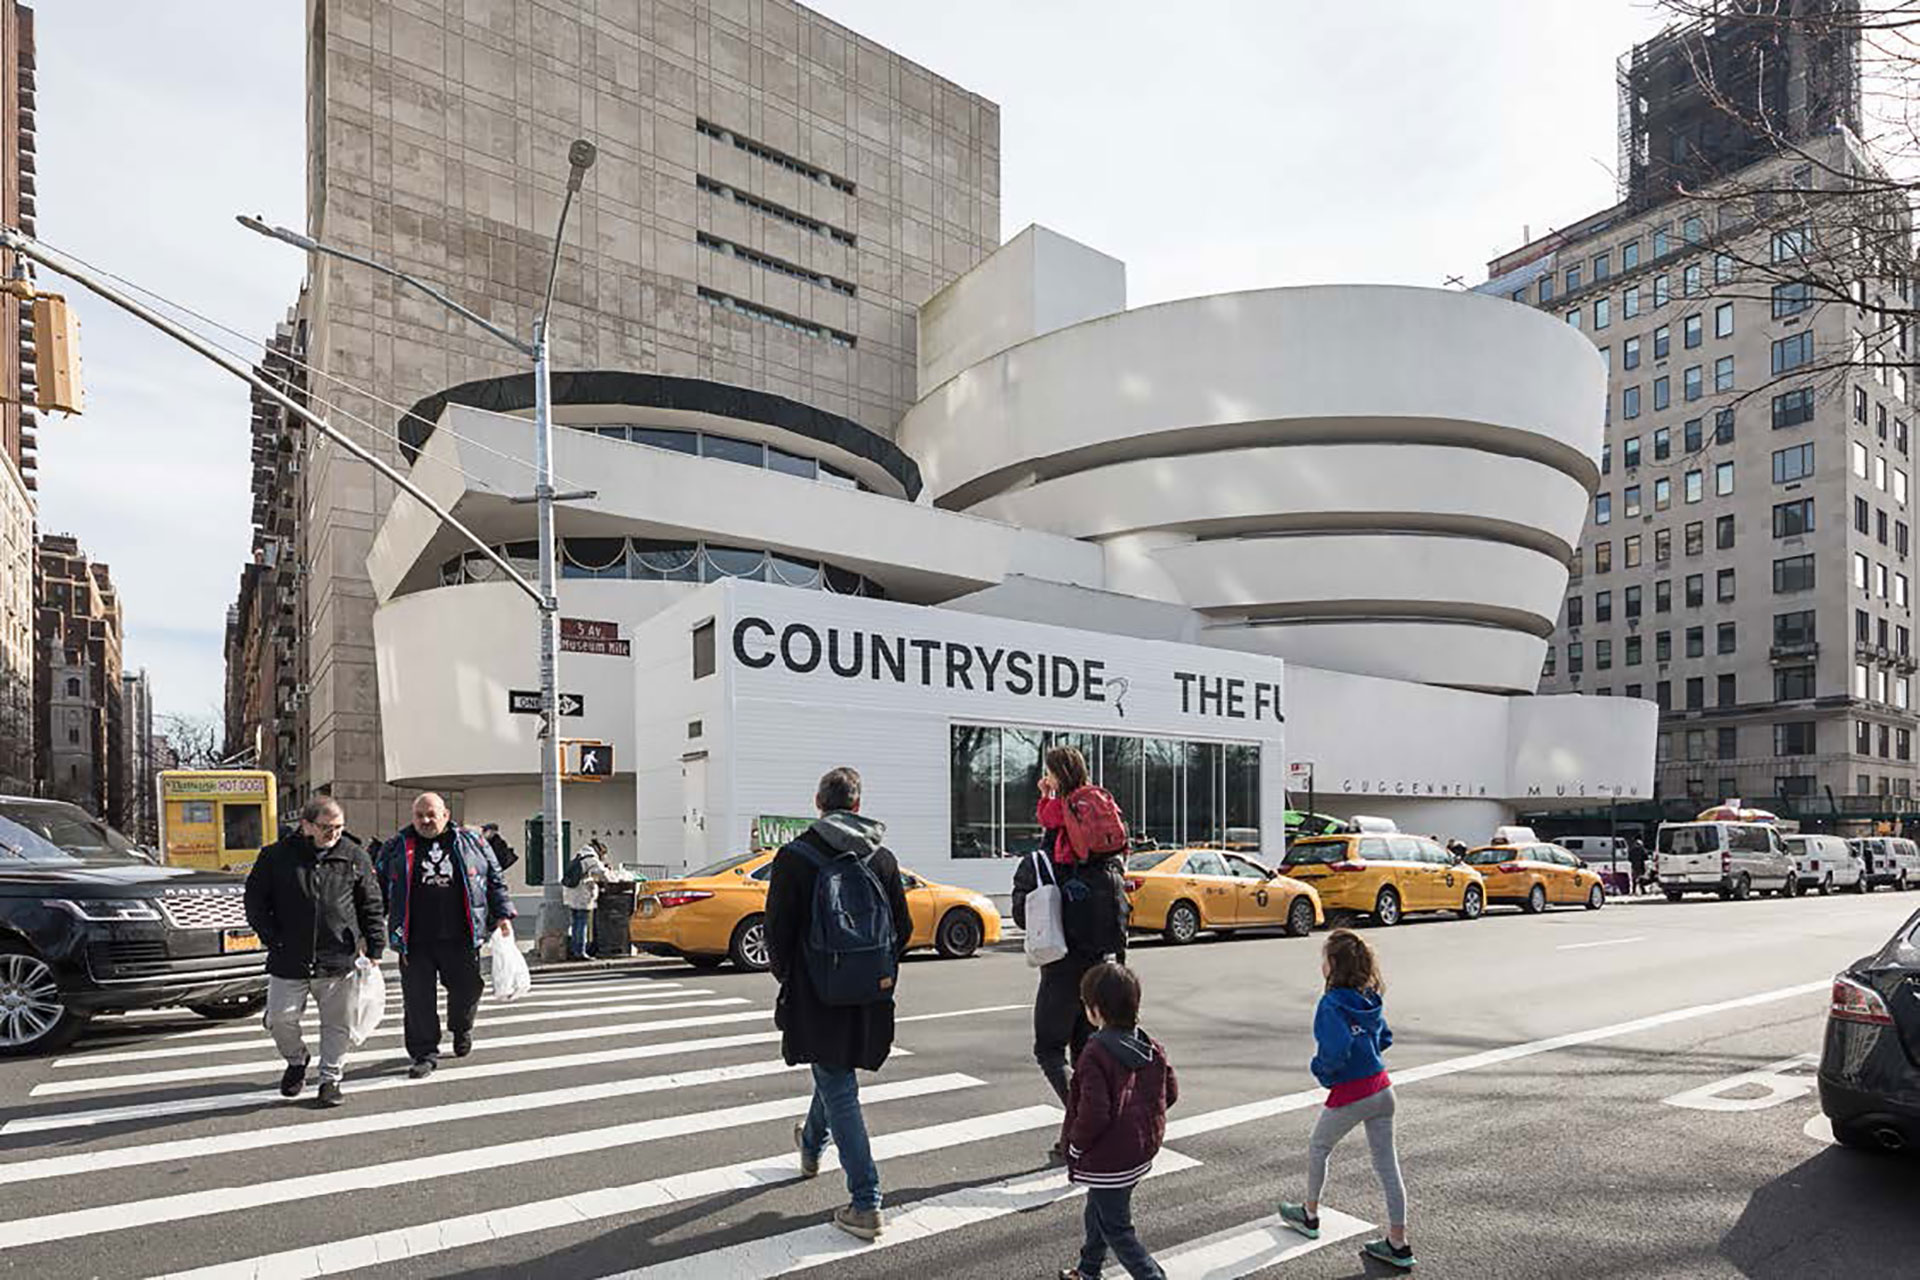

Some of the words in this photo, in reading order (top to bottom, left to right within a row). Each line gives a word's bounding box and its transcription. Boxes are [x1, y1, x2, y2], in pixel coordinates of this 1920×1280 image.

[561, 639, 605, 652] Museum
[608, 642, 629, 655] Mile
[732, 616, 1106, 702] COUNTRYSIDE
[1173, 671, 1245, 719] THE
